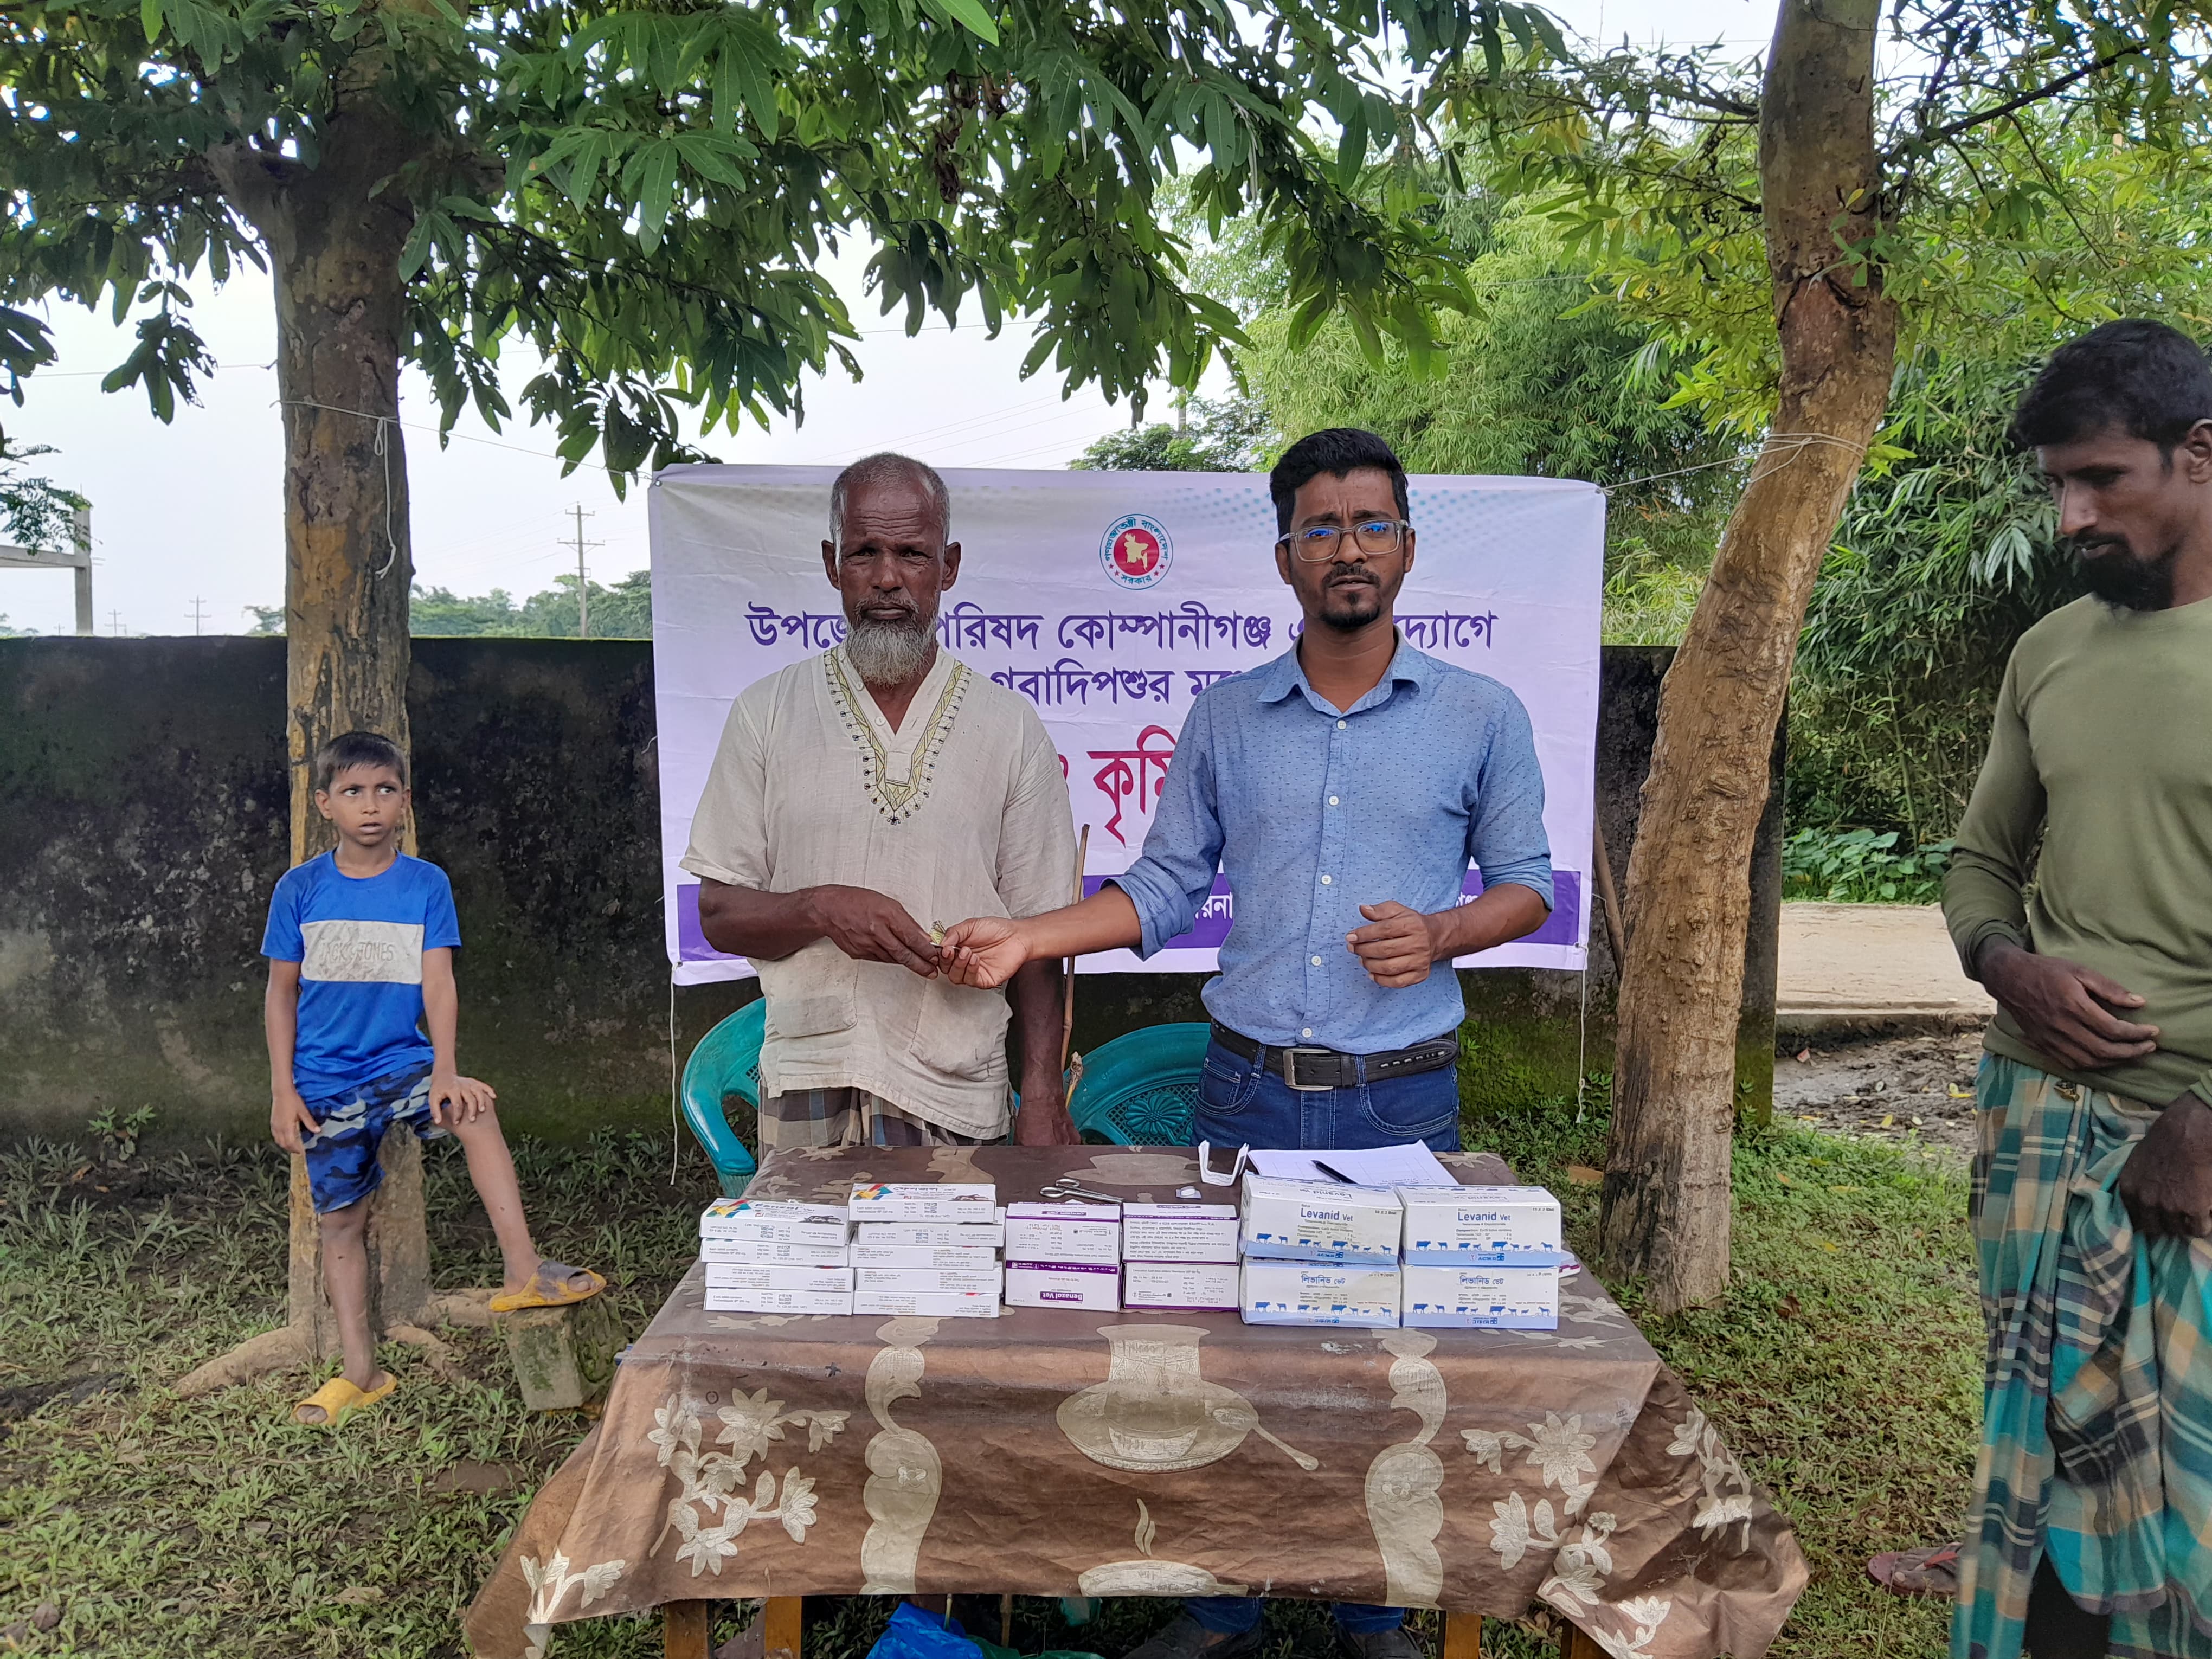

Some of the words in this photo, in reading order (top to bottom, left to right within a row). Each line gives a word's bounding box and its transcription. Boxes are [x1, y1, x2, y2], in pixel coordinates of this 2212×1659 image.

[1120, 574, 1152, 585] সরকার
[1058, 600, 1272, 651] কোম্পানীগঞ্জ
[1393, 609, 1500, 650] দ্যোগে
[1301, 1207, 1340, 1220] Levanid
[1458, 1211, 1497, 1221] Levanid
[1459, 1275, 1491, 1284] লিভানিড
